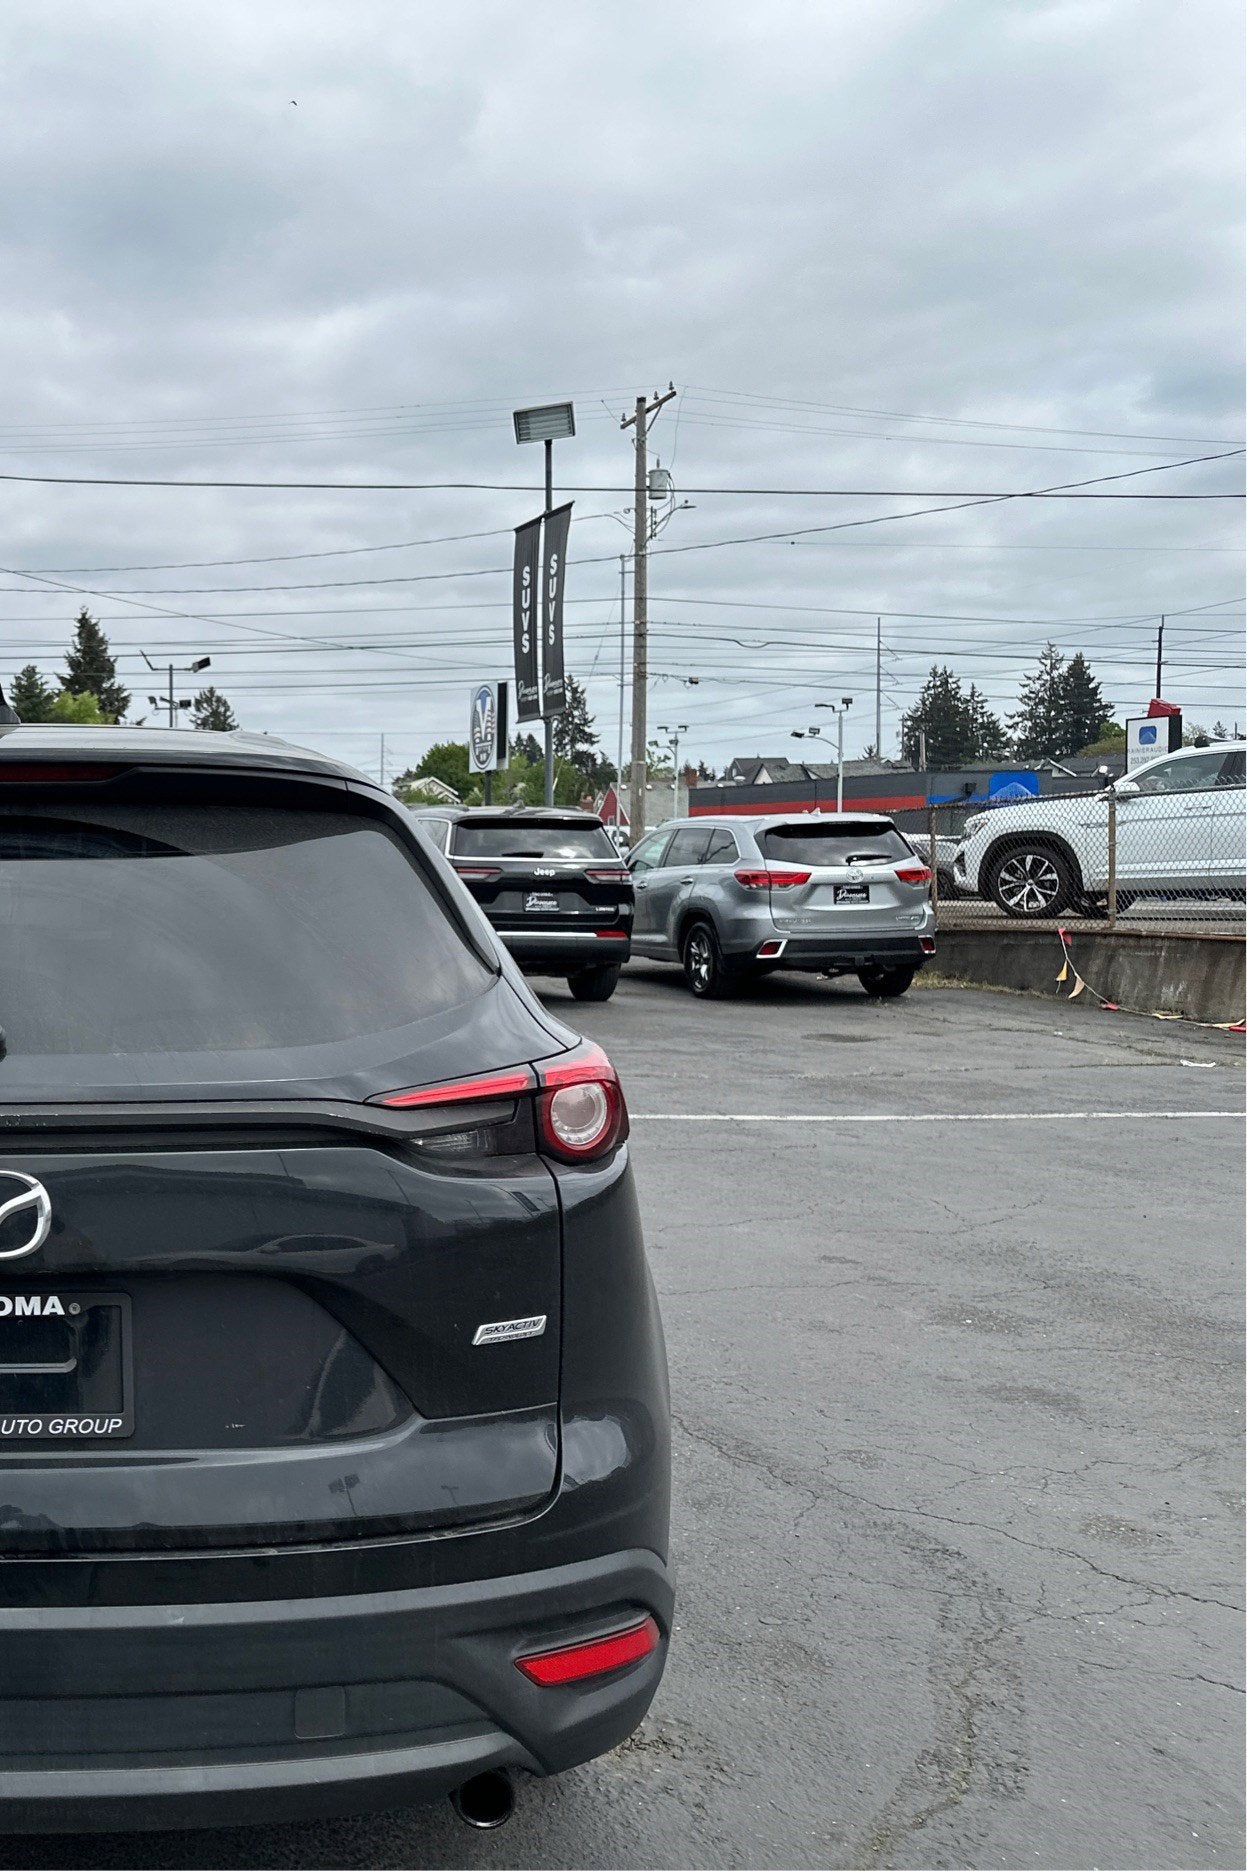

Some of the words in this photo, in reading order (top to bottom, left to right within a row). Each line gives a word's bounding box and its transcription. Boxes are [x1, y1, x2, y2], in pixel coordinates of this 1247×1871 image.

[548, 553, 558, 646] SUVS
[521, 565, 531, 654] SUVS
[533, 867, 556, 877] Jeep
[484, 1319, 541, 1335] SKYACTIV
[48, 1418, 123, 1434] GROUP
